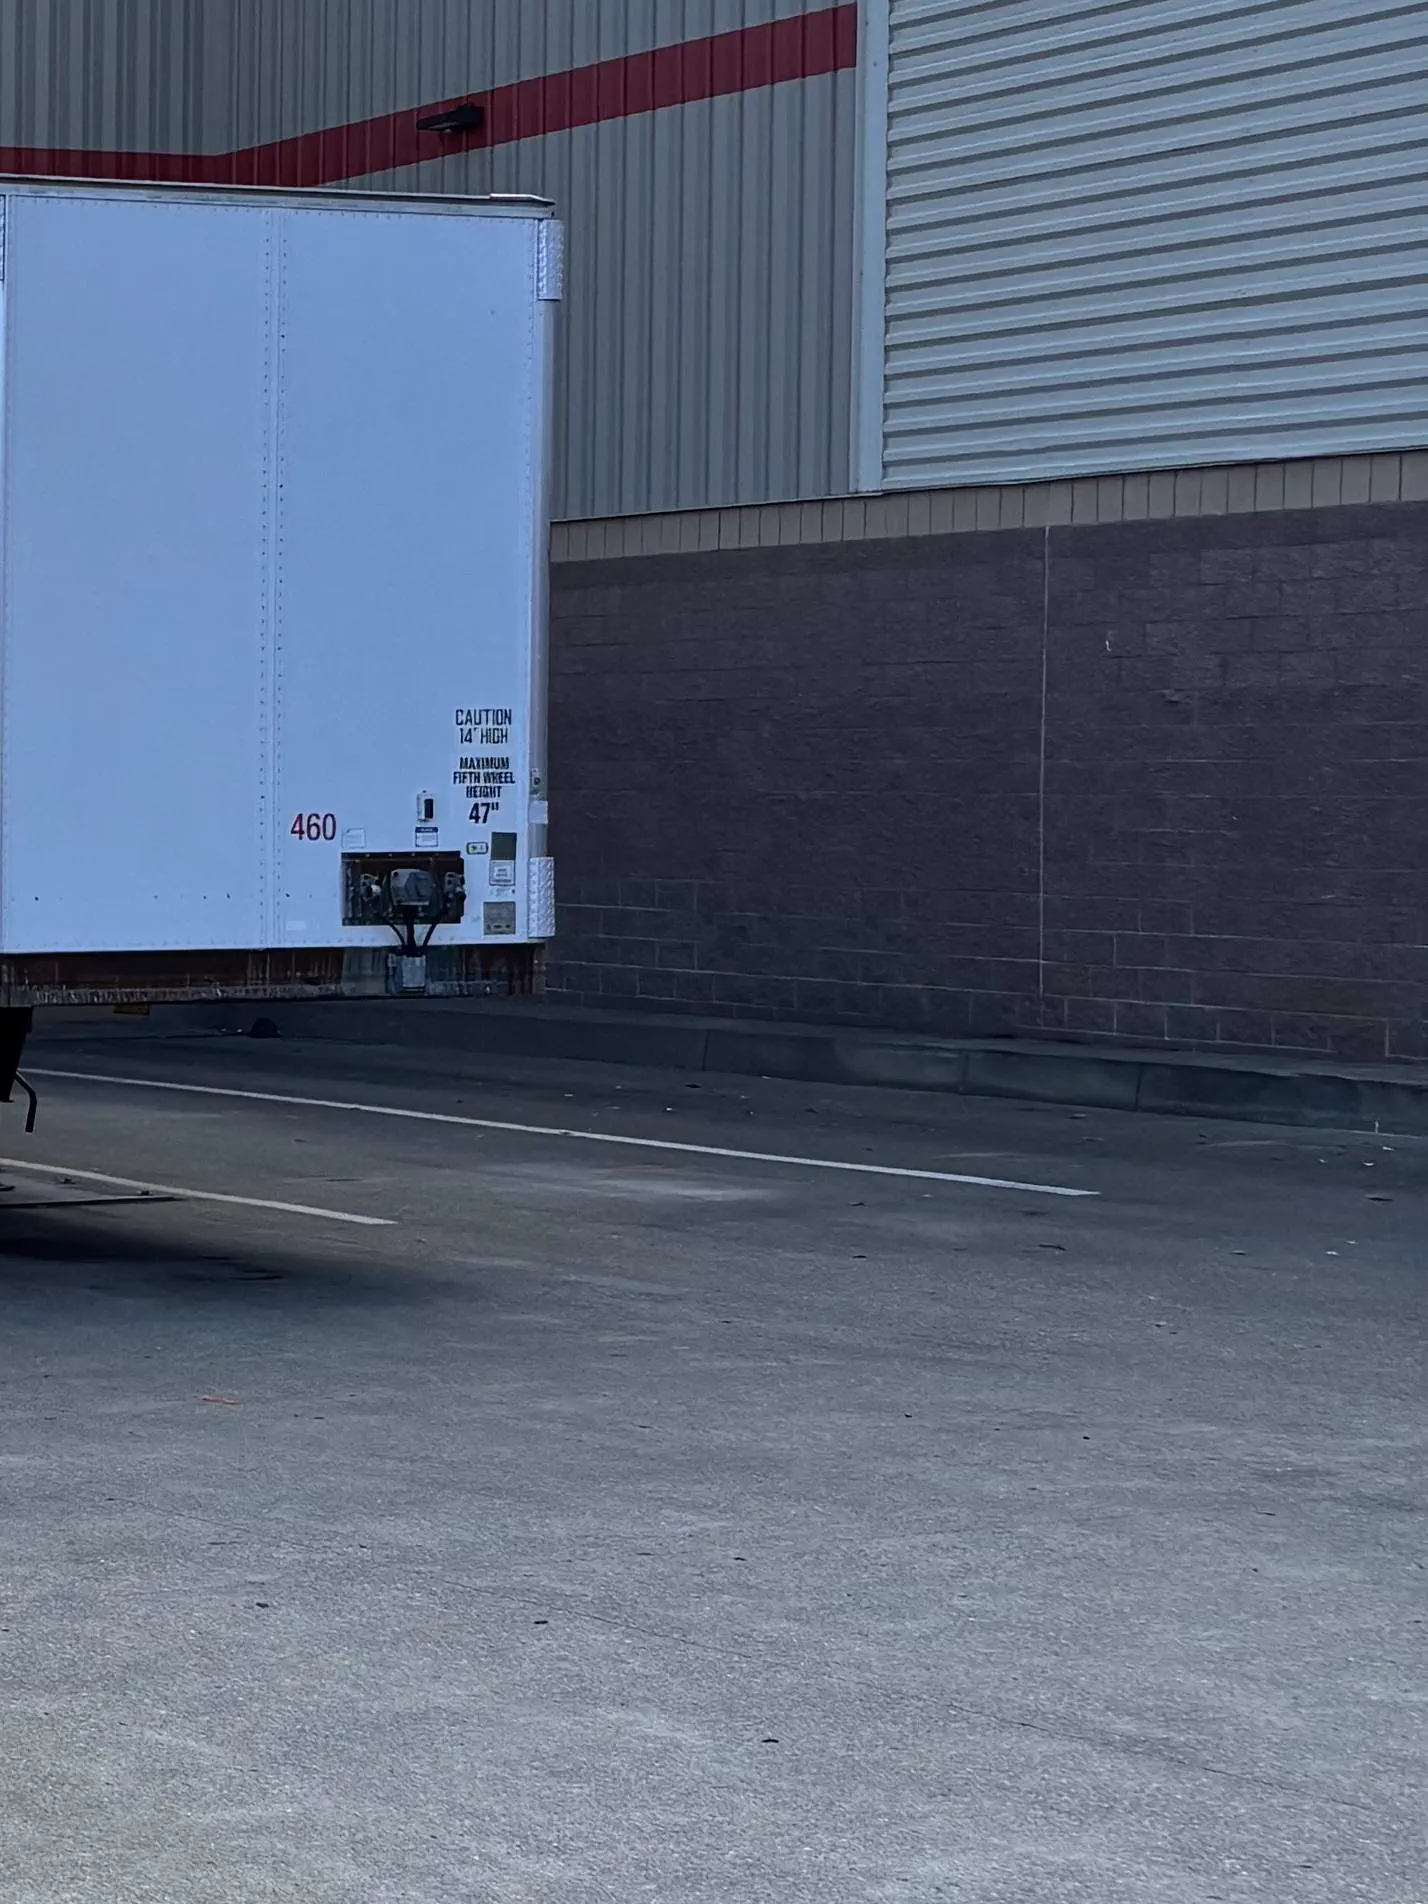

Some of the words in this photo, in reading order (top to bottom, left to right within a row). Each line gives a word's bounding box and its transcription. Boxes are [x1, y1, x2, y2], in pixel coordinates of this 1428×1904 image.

[455, 708, 512, 726] CAUTION
[480, 728, 509, 745] HIGH
[459, 757, 509, 770] MAXIMUM
[453, 772, 480, 785] FIFTH
[483, 772, 516, 784] WHEEL
[465, 785, 502, 799] HEIGHT
[290, 812, 337, 841] 460
